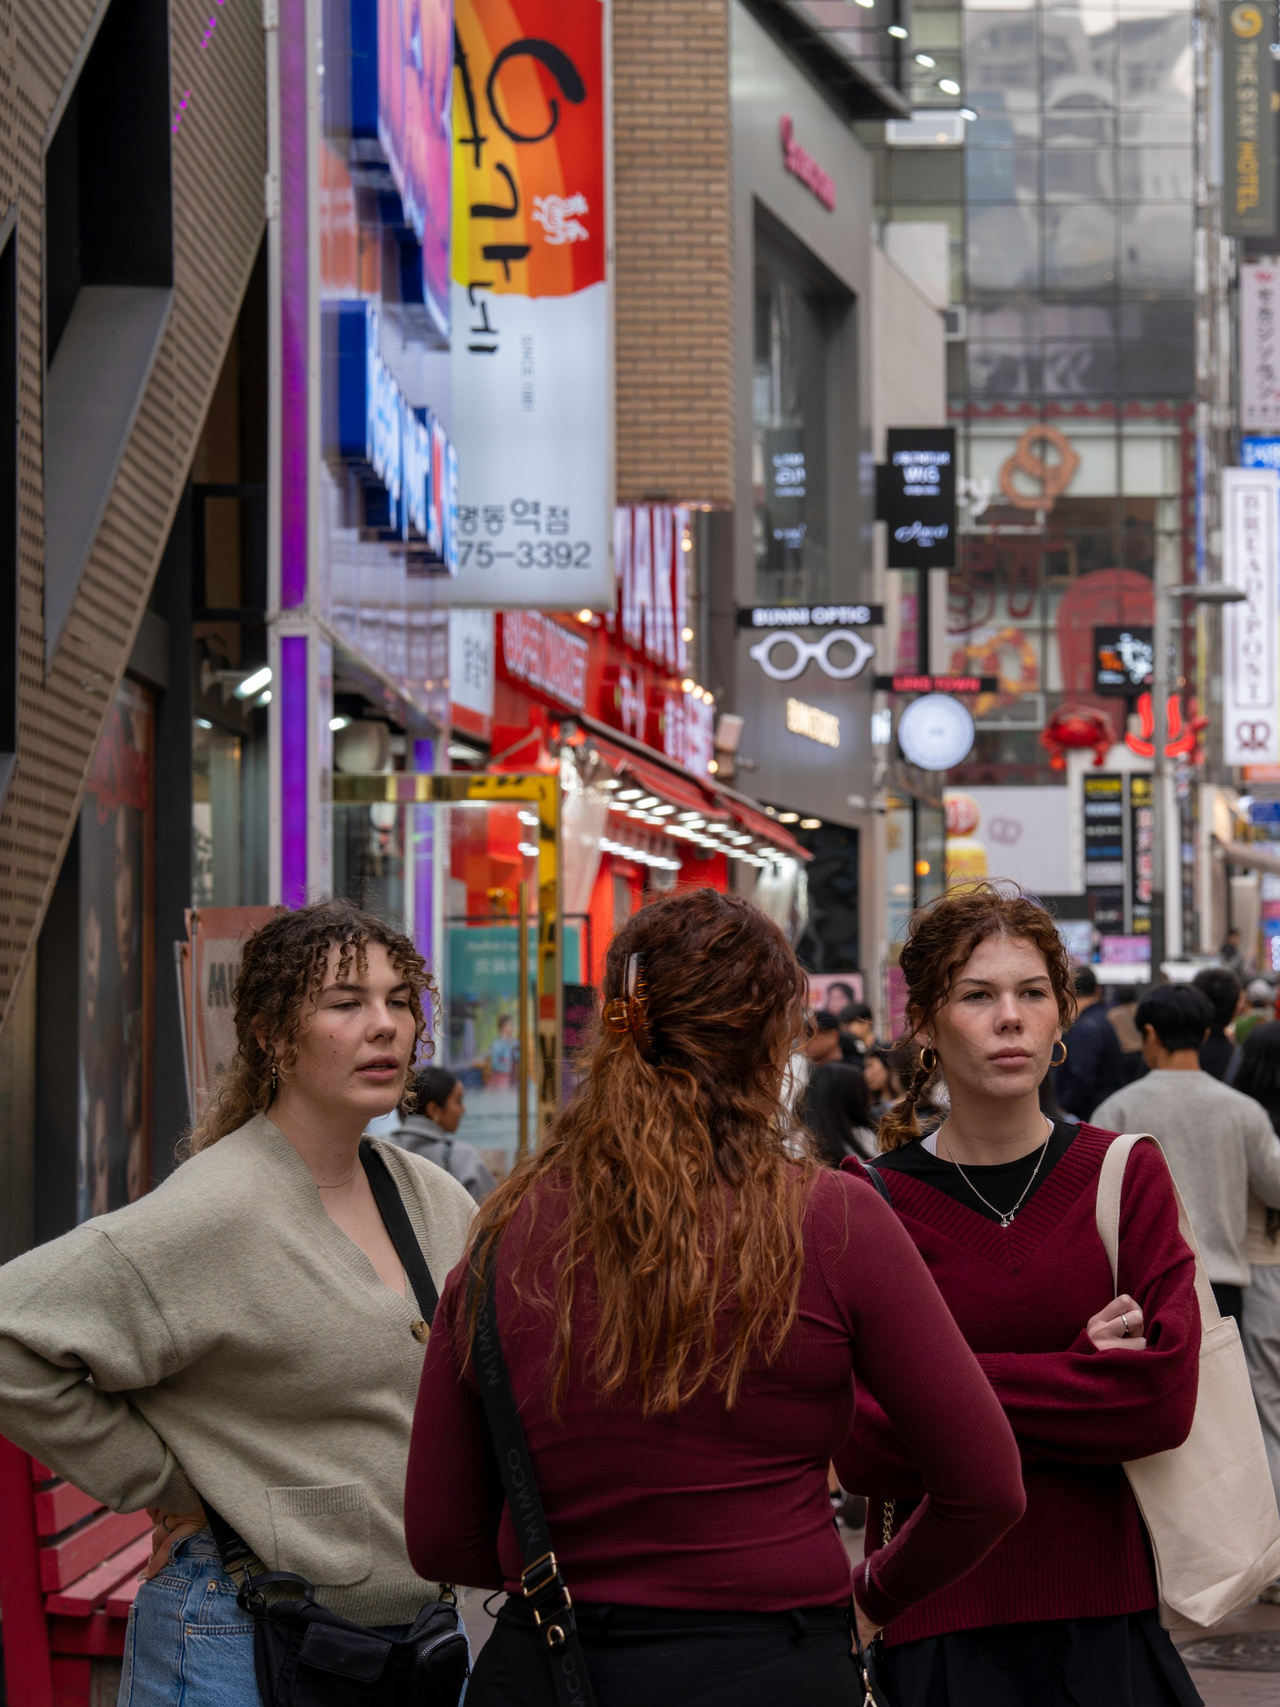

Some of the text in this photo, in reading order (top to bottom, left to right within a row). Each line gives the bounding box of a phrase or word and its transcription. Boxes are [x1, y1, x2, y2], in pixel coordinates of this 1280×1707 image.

[1236, 141, 1259, 215] HOTEL
[520, 334, 536, 378] SINCE
[902, 466, 941, 484] WIG
[810, 605, 871, 626] OPTIC
